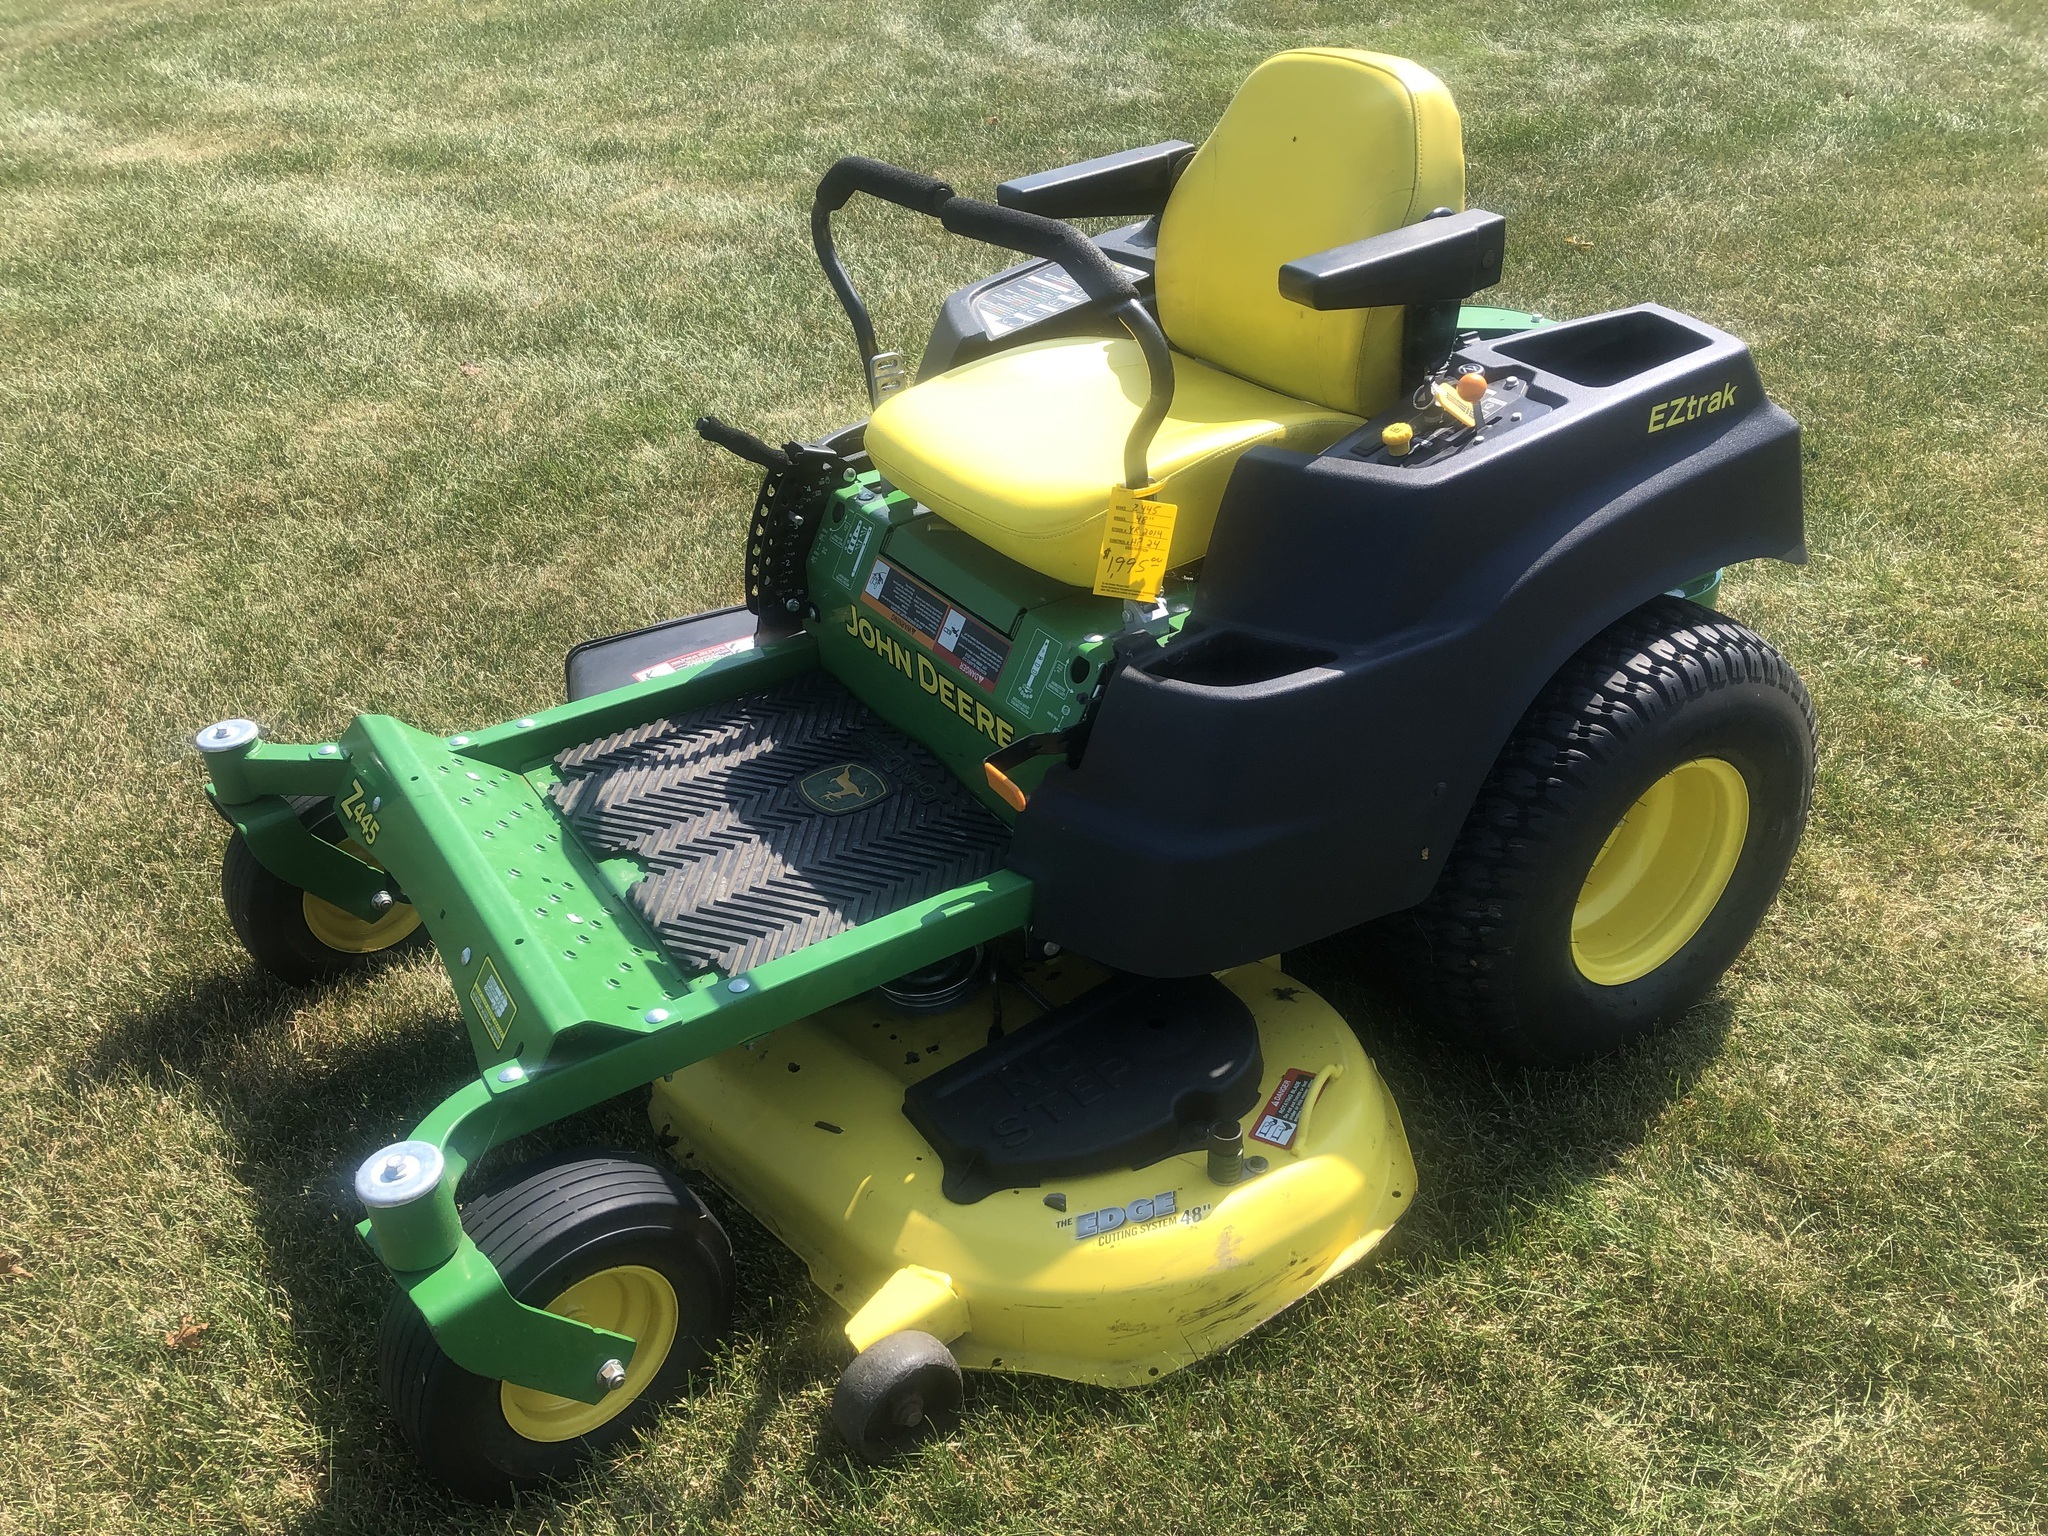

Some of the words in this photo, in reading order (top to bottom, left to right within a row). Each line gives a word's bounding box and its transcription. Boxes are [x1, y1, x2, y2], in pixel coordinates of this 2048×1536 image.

[1648, 382, 1738, 433] EZtrak
[1142, 527, 1163, 539] 2014
[1147, 540, 1161, 549] 24
[890, 613, 913, 633] WARNING
[845, 604, 913, 680] JOHN
[917, 652, 1015, 748] DEERE
[959, 663, 981, 681] DANGER
[341, 778, 380, 844] Z445
[1276, 1079, 1291, 1101] DANGER
[1278, 1093, 1293, 1113] ROTATING
[1055, 1217, 1073, 1229] THE
[1076, 1190, 1177, 1240] EDGE
[1098, 1225, 1138, 1247] CUTTING
[1140, 1216, 1177, 1234] SYSTEM
[1180, 1203, 1211, 1225] 48"
